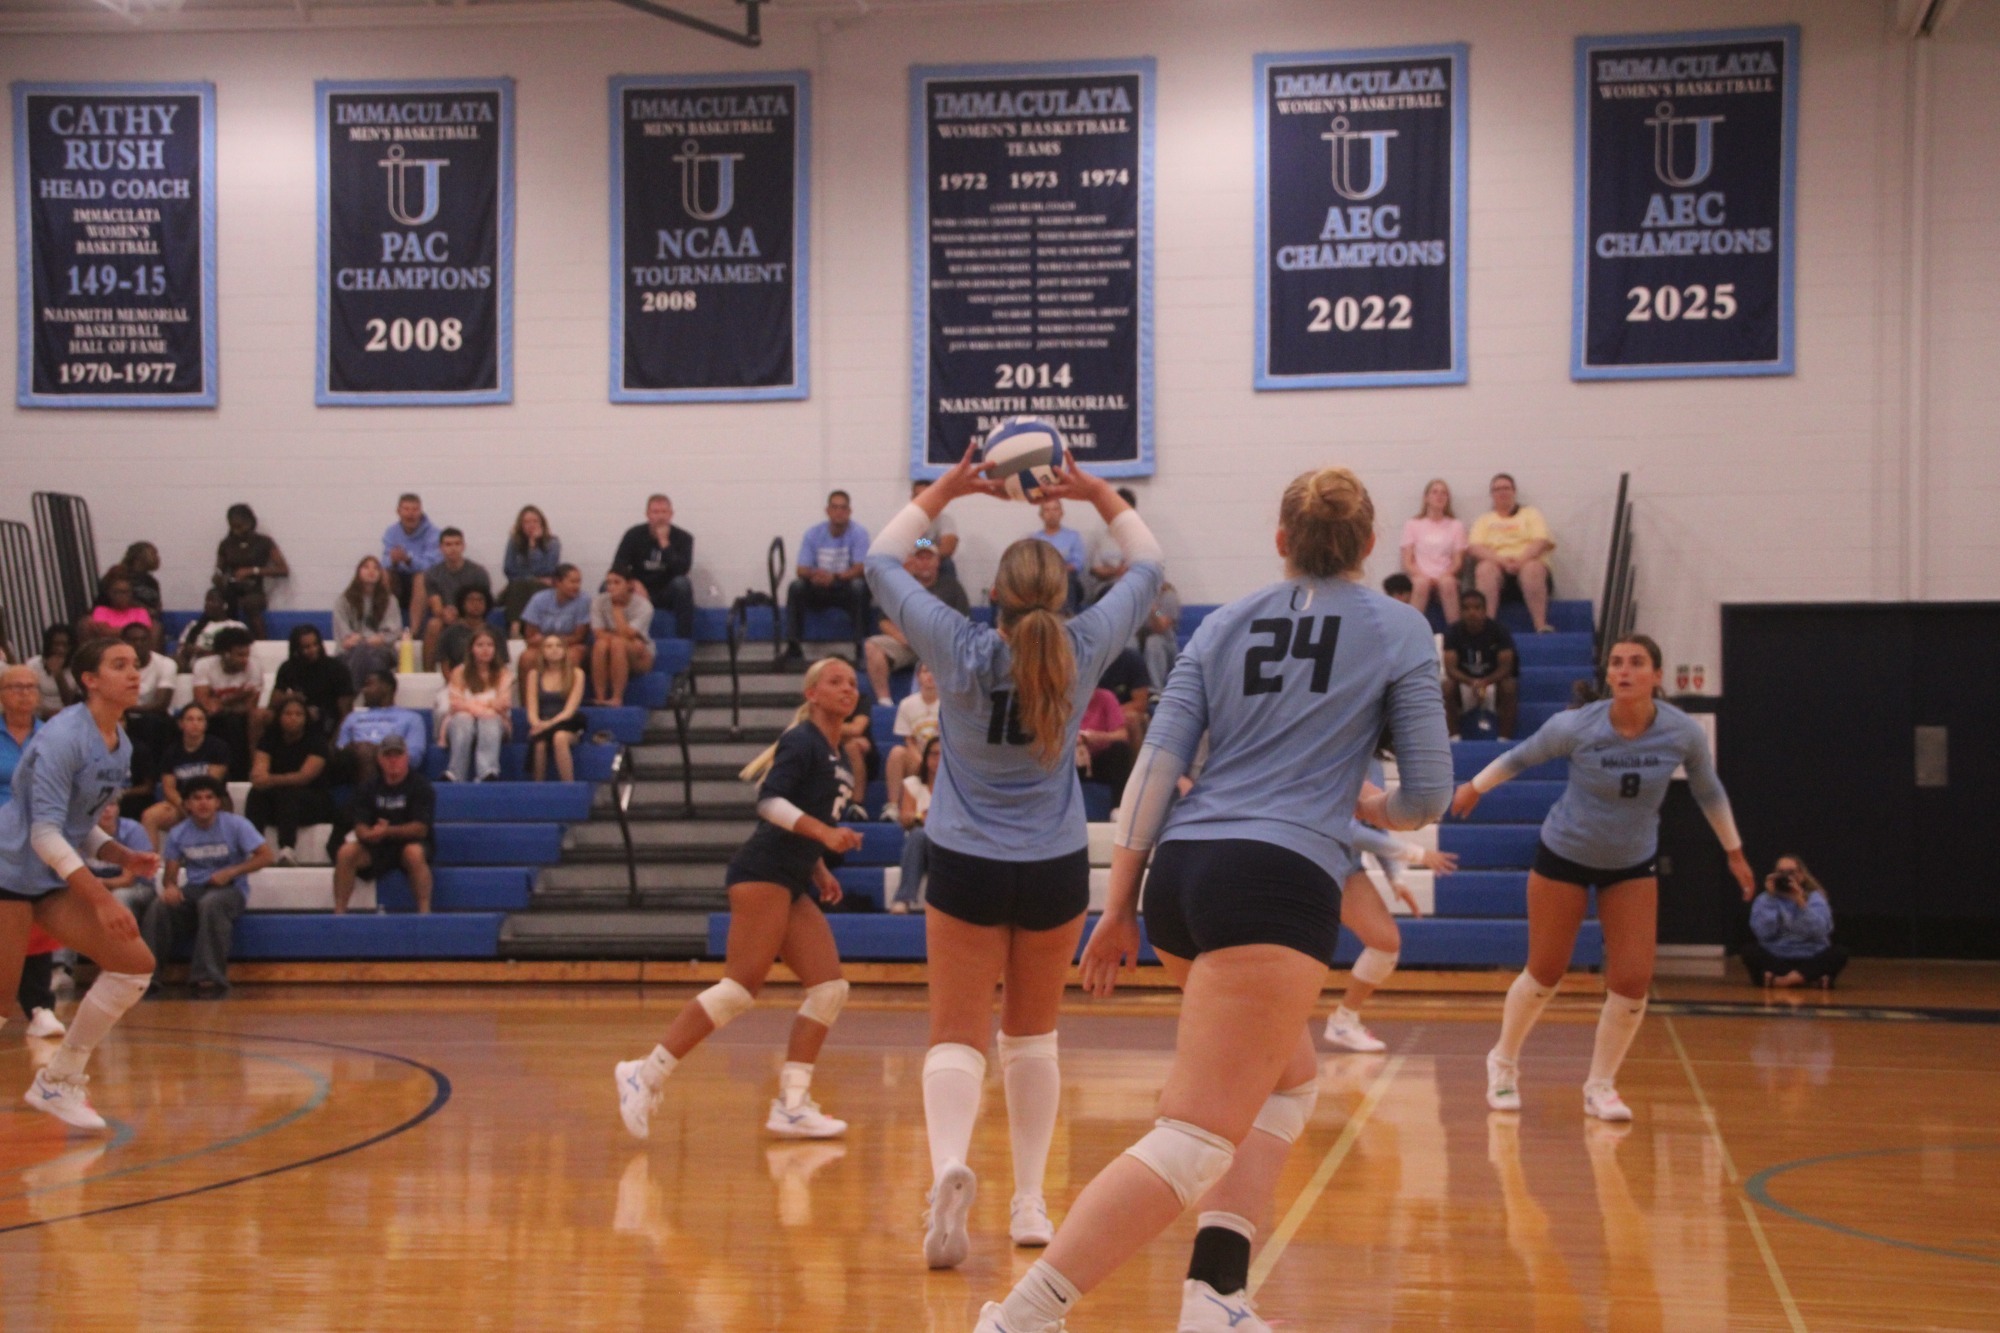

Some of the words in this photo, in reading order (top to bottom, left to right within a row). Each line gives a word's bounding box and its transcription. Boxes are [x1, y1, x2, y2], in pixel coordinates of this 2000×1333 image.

[1597, 51, 1778, 83] IMMACULATA
[1274, 68, 1445, 98] IMMACULATA
[1599, 82, 1672, 99] WOMEN'S
[1675, 78, 1774, 95] BASKETBALL
[336, 103, 493, 125] IMMACULATA
[630, 96, 788, 120] IMMACULATA
[934, 87, 1132, 119] IMMACULATA
[1277, 98, 1347, 115] WOMEN'S
[1349, 93, 1443, 111] BASKETBALL
[50, 106, 178, 136] CATHY
[643, 122, 686, 137] MEN'S
[688, 120, 774, 135] BASKETBALL
[938, 122, 1017, 138] WOMEN'S
[1020, 119, 1131, 136] BASKETBALL
[350, 127, 391, 142] MEN'S
[393, 125, 479, 140] BASKETBALL
[64, 140, 165, 170] RUSH
[1006, 141, 1061, 156] TEAMS
[40, 179, 106, 199] HEAD
[112, 179, 190, 199] COACH
[939, 173, 989, 191] 1972
[1009, 171, 1059, 189] 1973
[1080, 169, 1130, 187] 1974
[73, 208, 161, 222] IMMACULATA
[1641, 192, 1726, 228] AEC
[85, 224, 150, 238] WOMEN'S
[1319, 205, 1400, 240] AEC
[76, 241, 159, 254] BASKETBALL
[381, 232, 449, 263] PAC
[656, 227, 761, 259] NCAA
[1596, 229, 1772, 258] CHAMPIONS
[1276, 240, 1445, 271] CHAMPIONS
[67, 265, 167, 296] 149-15
[337, 267, 491, 291] CHAMPIONS
[632, 263, 787, 286] TOURNAMENT
[642, 291, 697, 312] 2008
[1307, 295, 1413, 332] 2022
[1626, 283, 1738, 321] 2025
[44, 308, 113, 322] NAISMITH
[116, 308, 189, 322] MEMORIAL
[74, 325, 161, 338] BASKETBALL
[365, 318, 463, 352] 2008
[69, 340, 104, 354] HALL
[109, 340, 128, 353] OF
[130, 340, 167, 353] FAME
[59, 363, 176, 384] 1970-1977
[995, 363, 1073, 389] 2014
[939, 396, 1027, 413] NAISMITH
[1030, 395, 1128, 411] MEMORIAL
[1243, 615, 1341, 696] 24
[1620, 772, 1641, 798] 8
